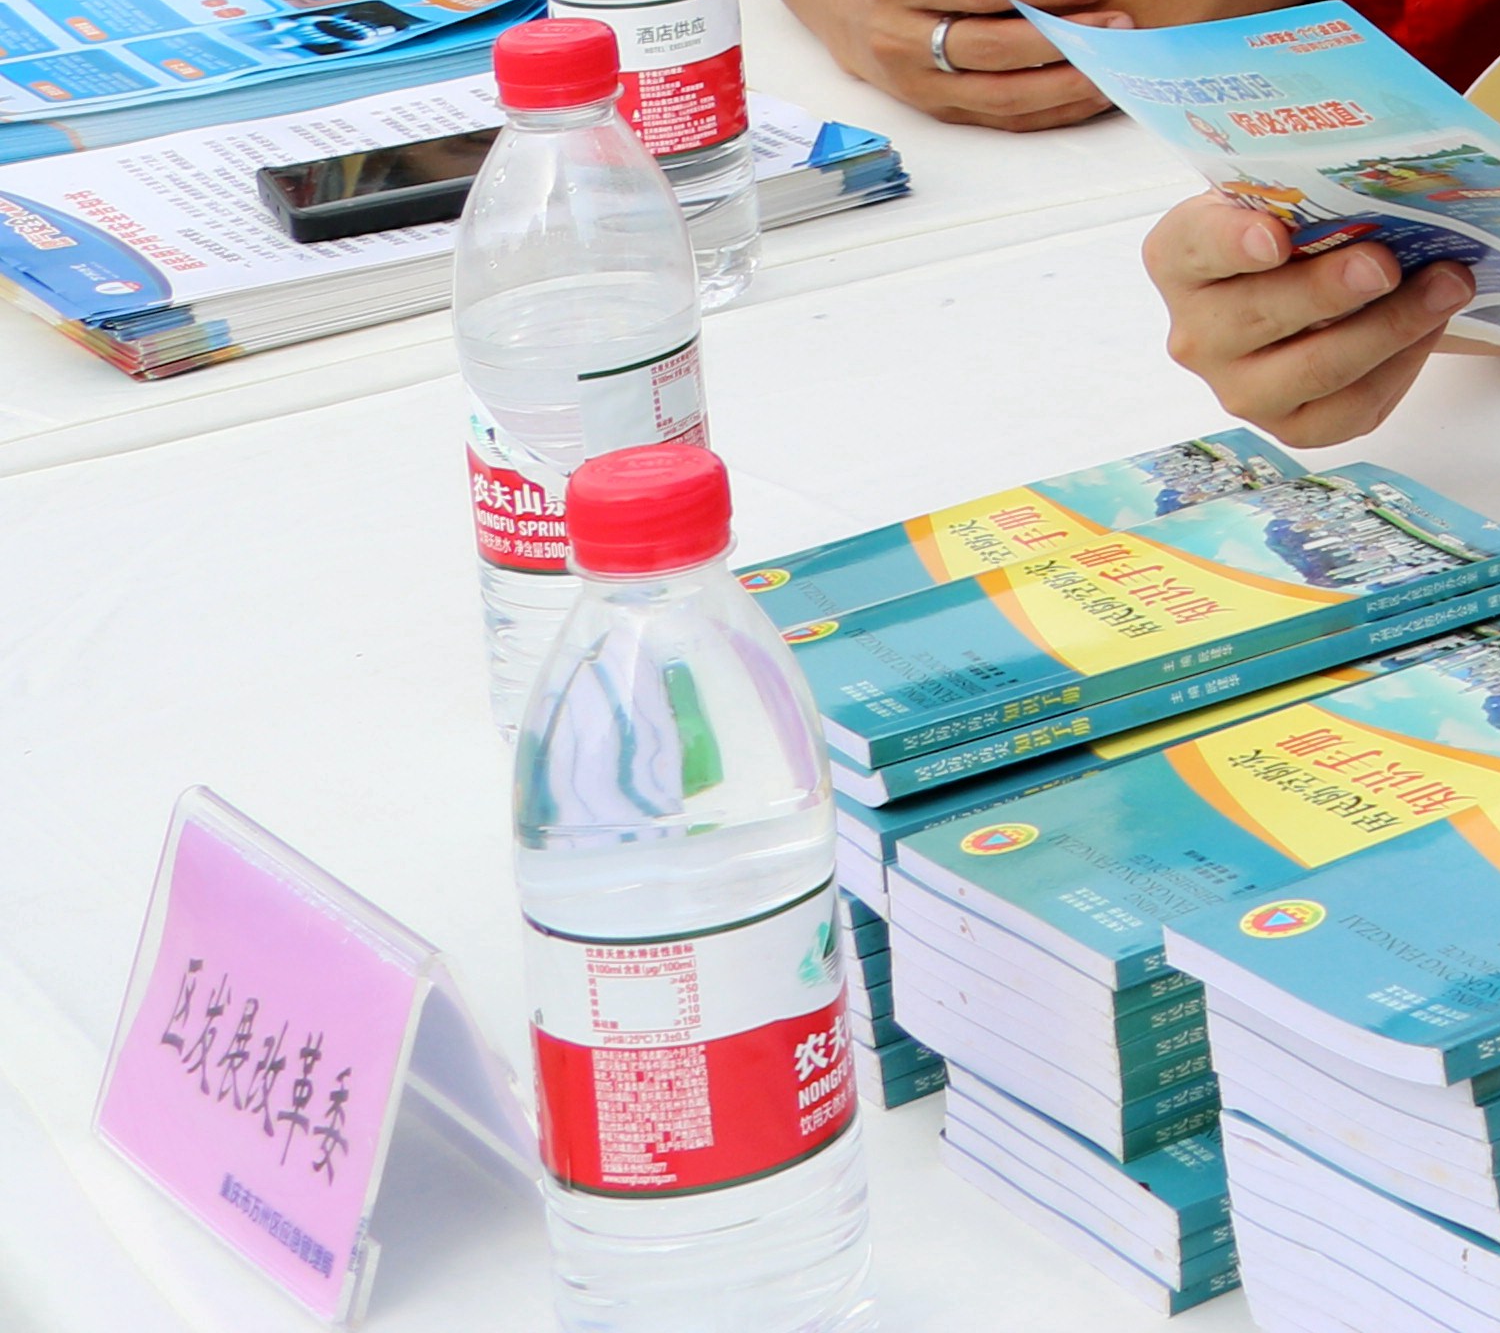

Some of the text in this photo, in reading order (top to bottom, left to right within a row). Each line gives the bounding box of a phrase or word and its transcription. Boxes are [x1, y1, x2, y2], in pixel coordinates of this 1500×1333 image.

[635, 17, 706, 45] 酒店供应
[516, 520, 567, 537] SPRIN
[1022, 557, 1166, 641] 居民防空防灾
[1069, 543, 1233, 625] 知识手册
[902, 702, 1001, 755] 居民防空防灾
[1000, 684, 1082, 724] 知识手册
[1162, 655, 1178, 674] 主
[914, 738, 1013, 785] 居民防空防灾
[1012, 716, 1092, 760] 知识手册
[1169, 687, 1185, 706] 主
[1227, 746, 1404, 836] 居民防空防灾
[1272, 727, 1476, 816] 知识手册
[585, 944, 694, 959] 饮用天然水特征性指标
[160, 957, 352, 1185] 区发展改革委
[793, 1011, 849, 1082] 农夫
